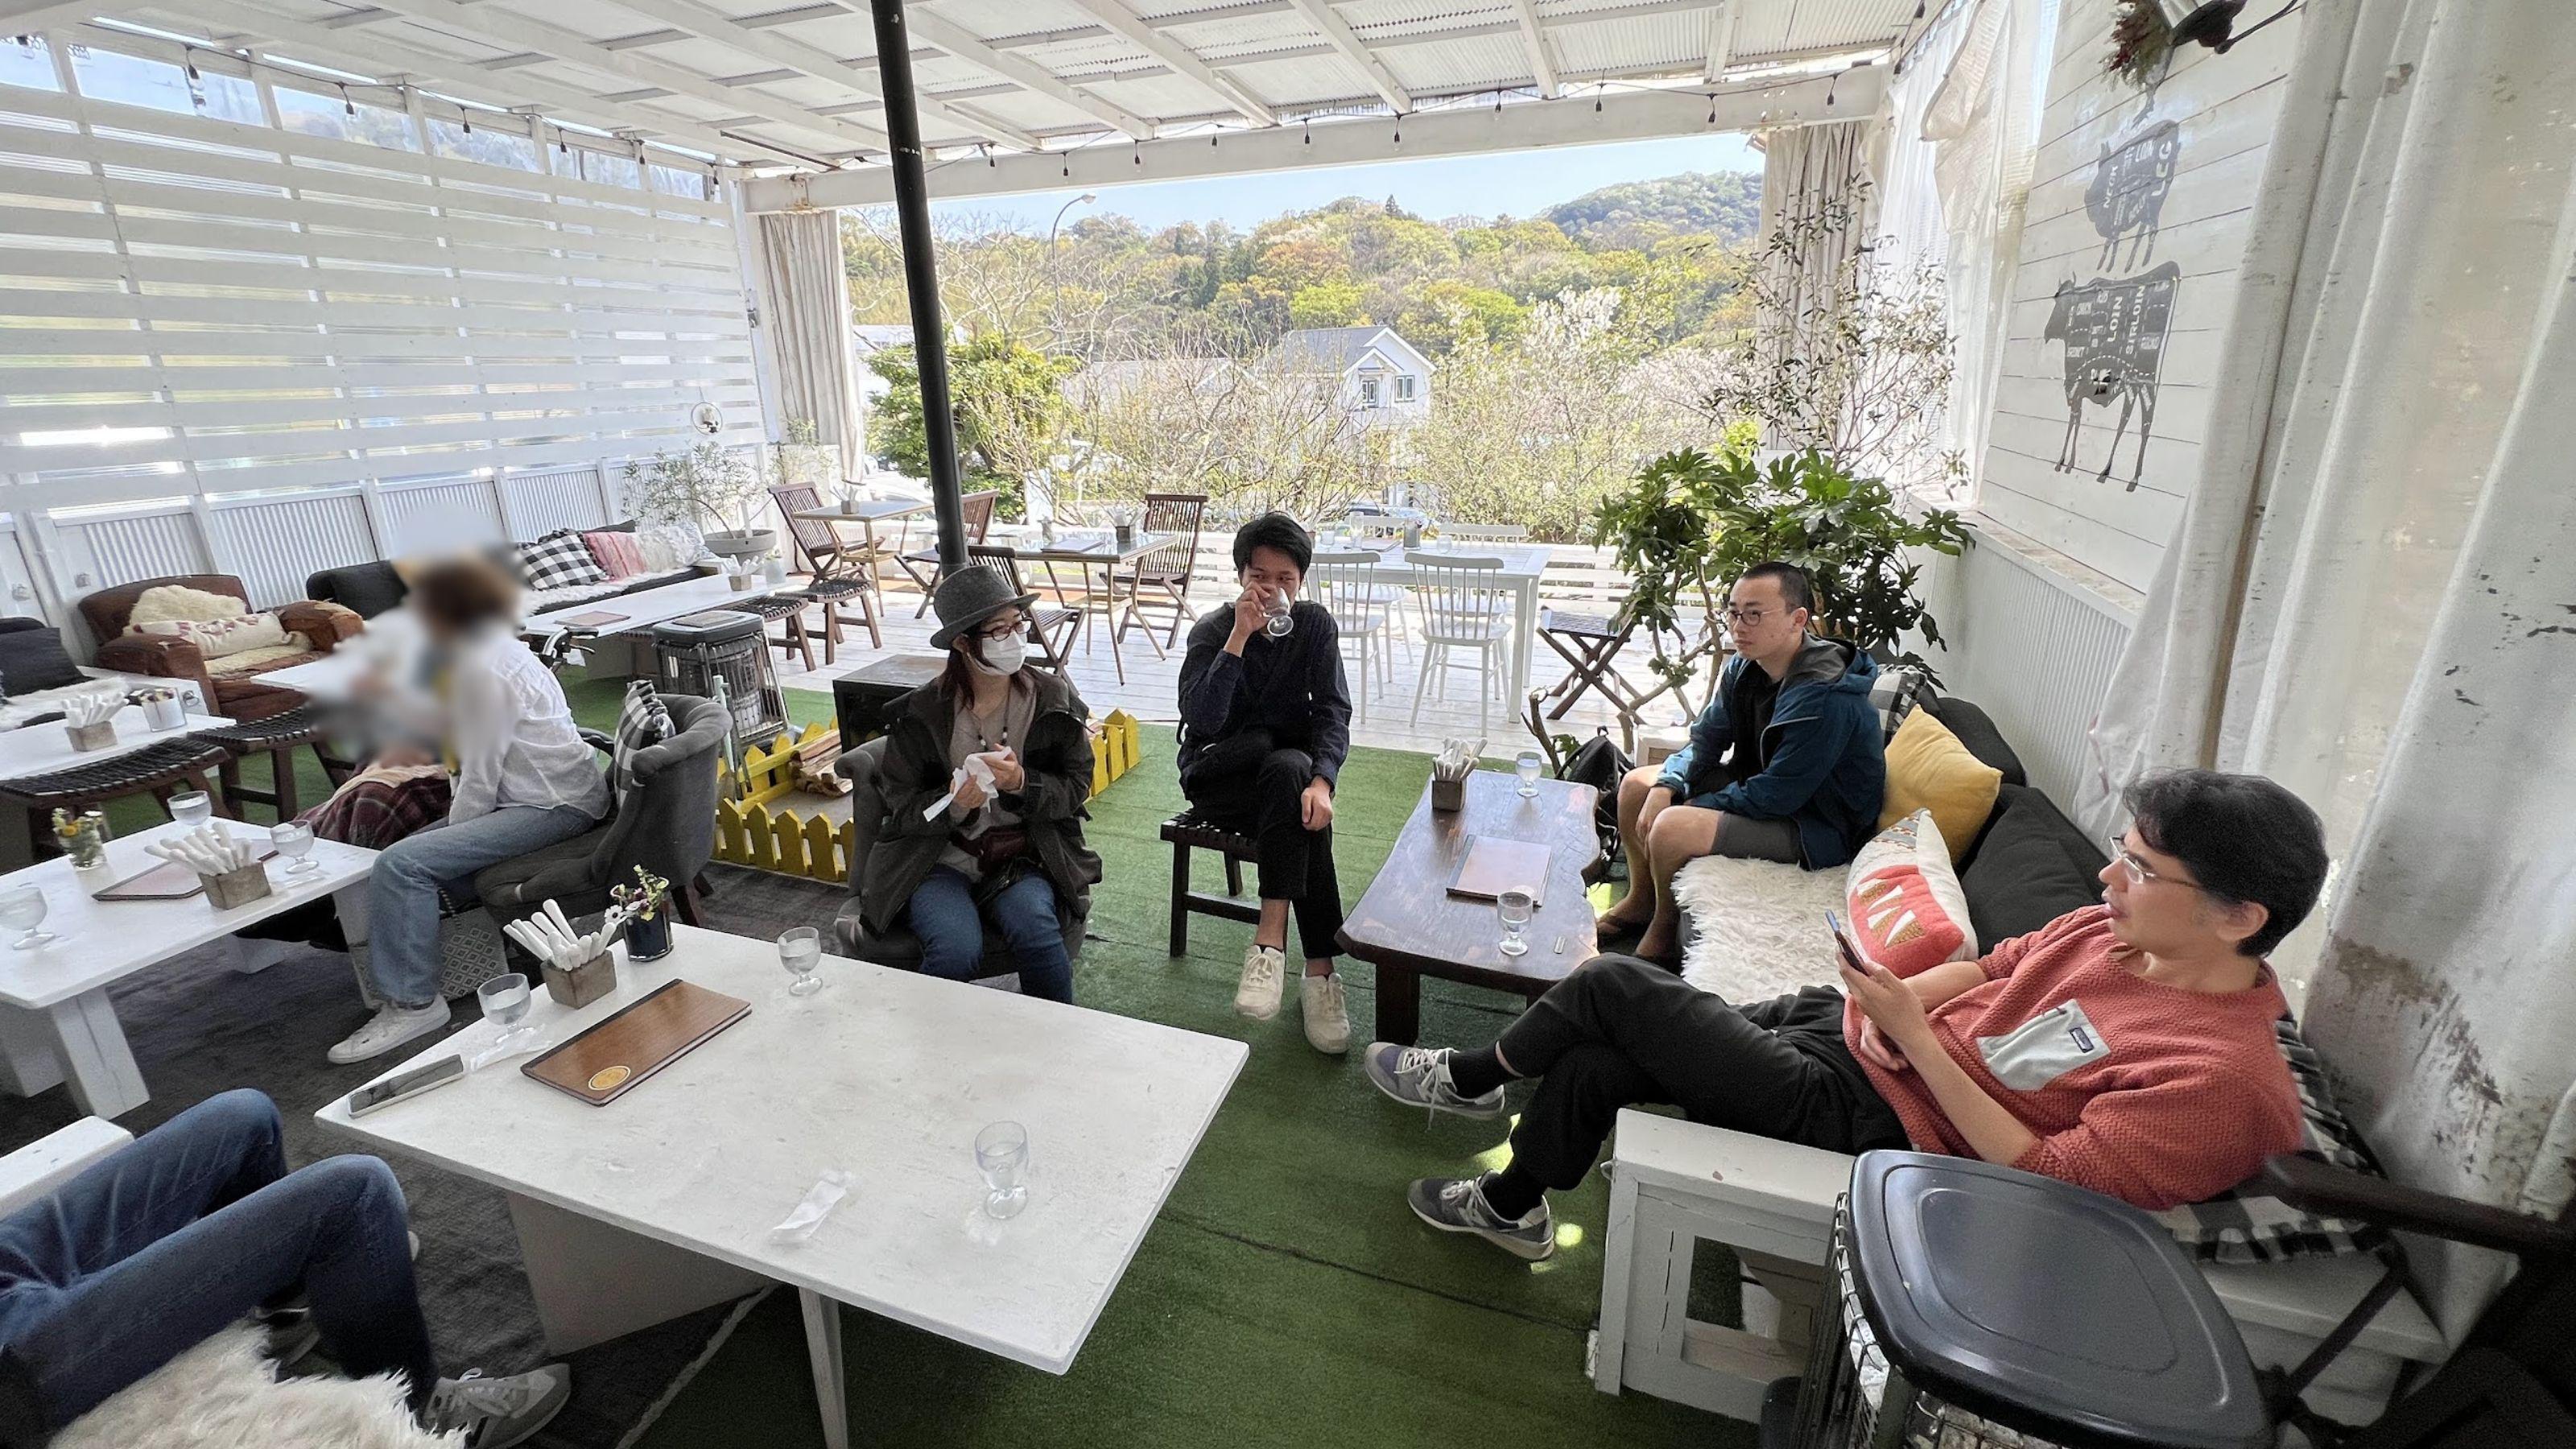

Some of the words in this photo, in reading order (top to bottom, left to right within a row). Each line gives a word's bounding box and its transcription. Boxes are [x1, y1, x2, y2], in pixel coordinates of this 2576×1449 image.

[2151, 141, 2172, 196] LEG
[2107, 296, 2123, 342] LOIN
[2125, 285, 2145, 354] SIRLOIN
